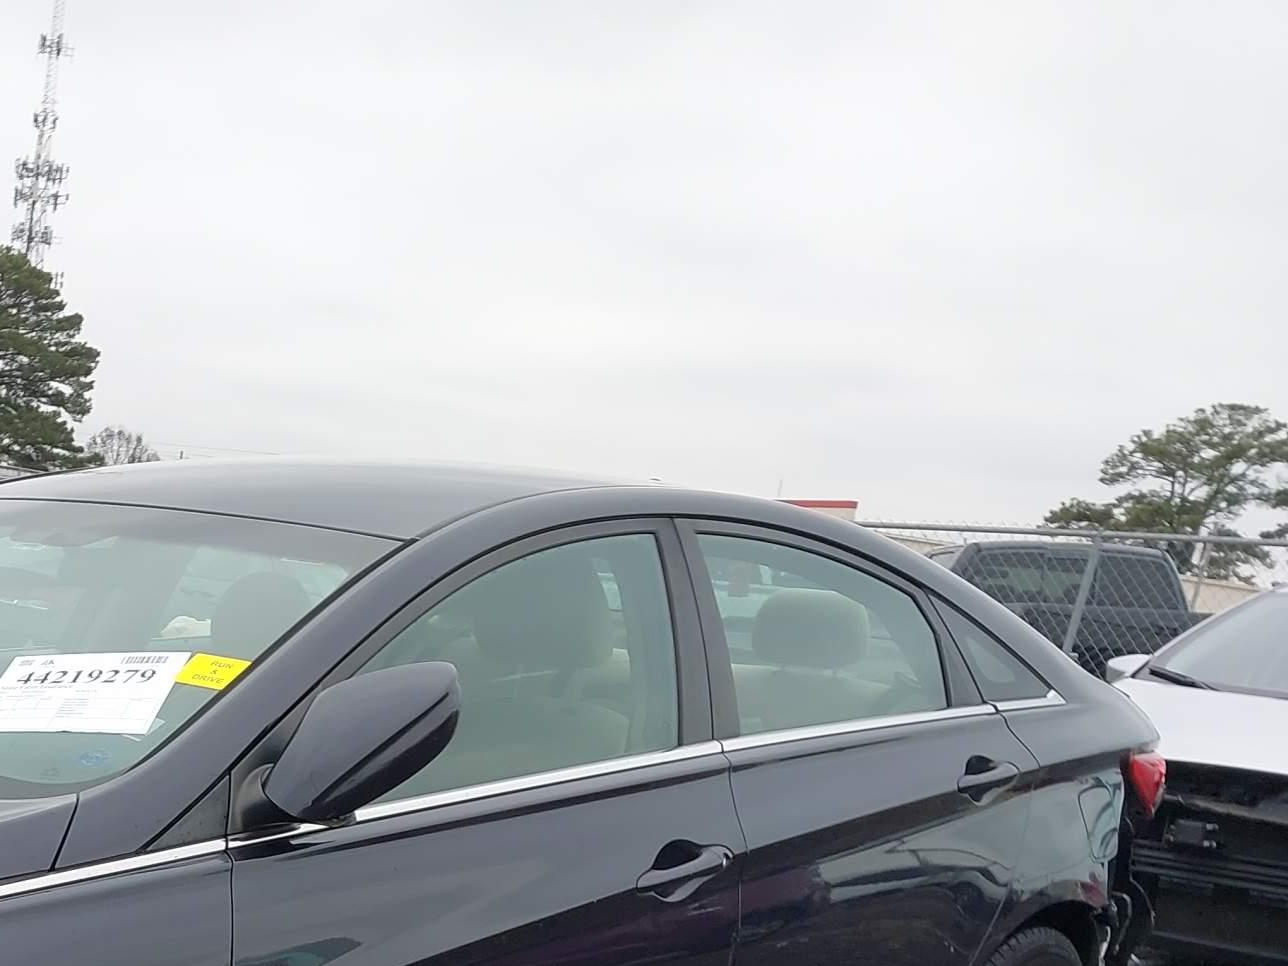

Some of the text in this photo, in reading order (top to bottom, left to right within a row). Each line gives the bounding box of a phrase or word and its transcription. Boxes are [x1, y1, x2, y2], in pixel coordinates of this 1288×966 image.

[210, 660, 233, 669] RUN
[16, 668, 157, 685] 44219279
[191, 673, 225, 684] DRIVE
